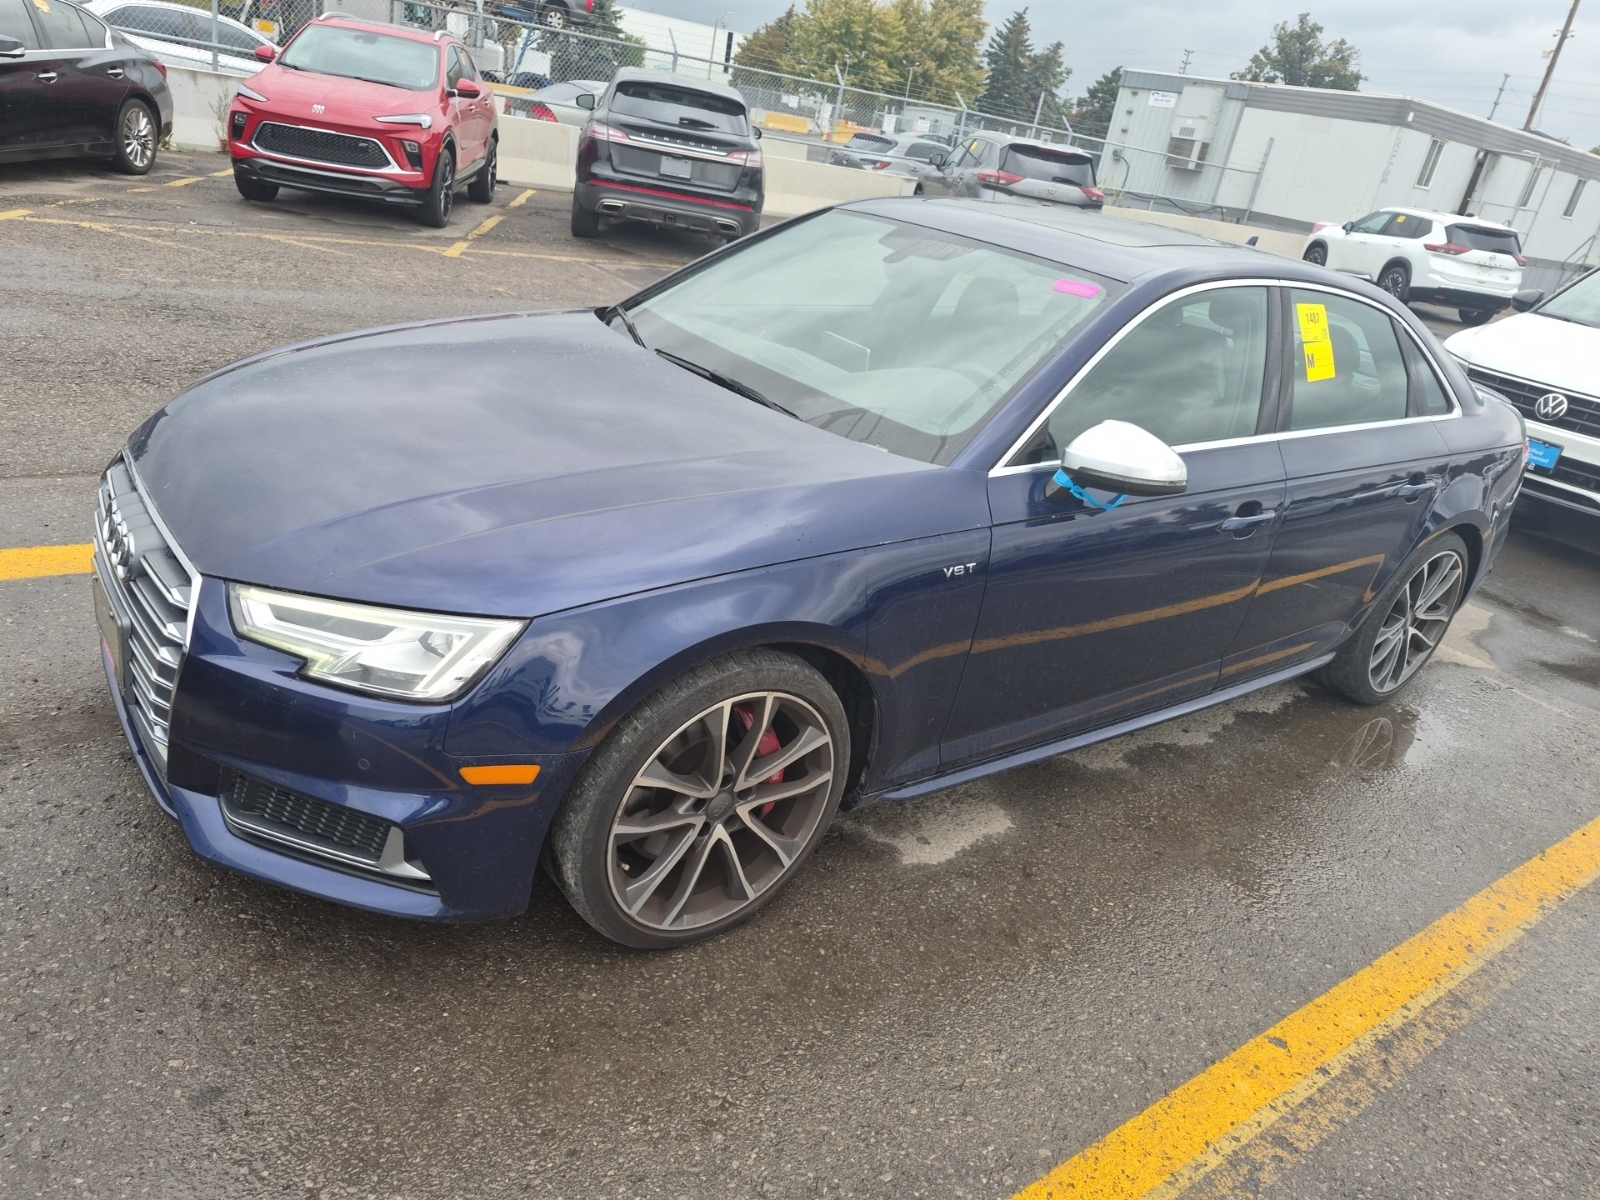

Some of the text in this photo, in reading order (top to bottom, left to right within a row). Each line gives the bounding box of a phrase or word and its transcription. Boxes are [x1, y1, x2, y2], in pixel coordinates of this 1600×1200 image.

[641, 132, 718, 150] LINCOLN
[1305, 312, 1320, 324] 1487
[1306, 353, 1316, 369] M
[943, 562, 977, 578] V6T
